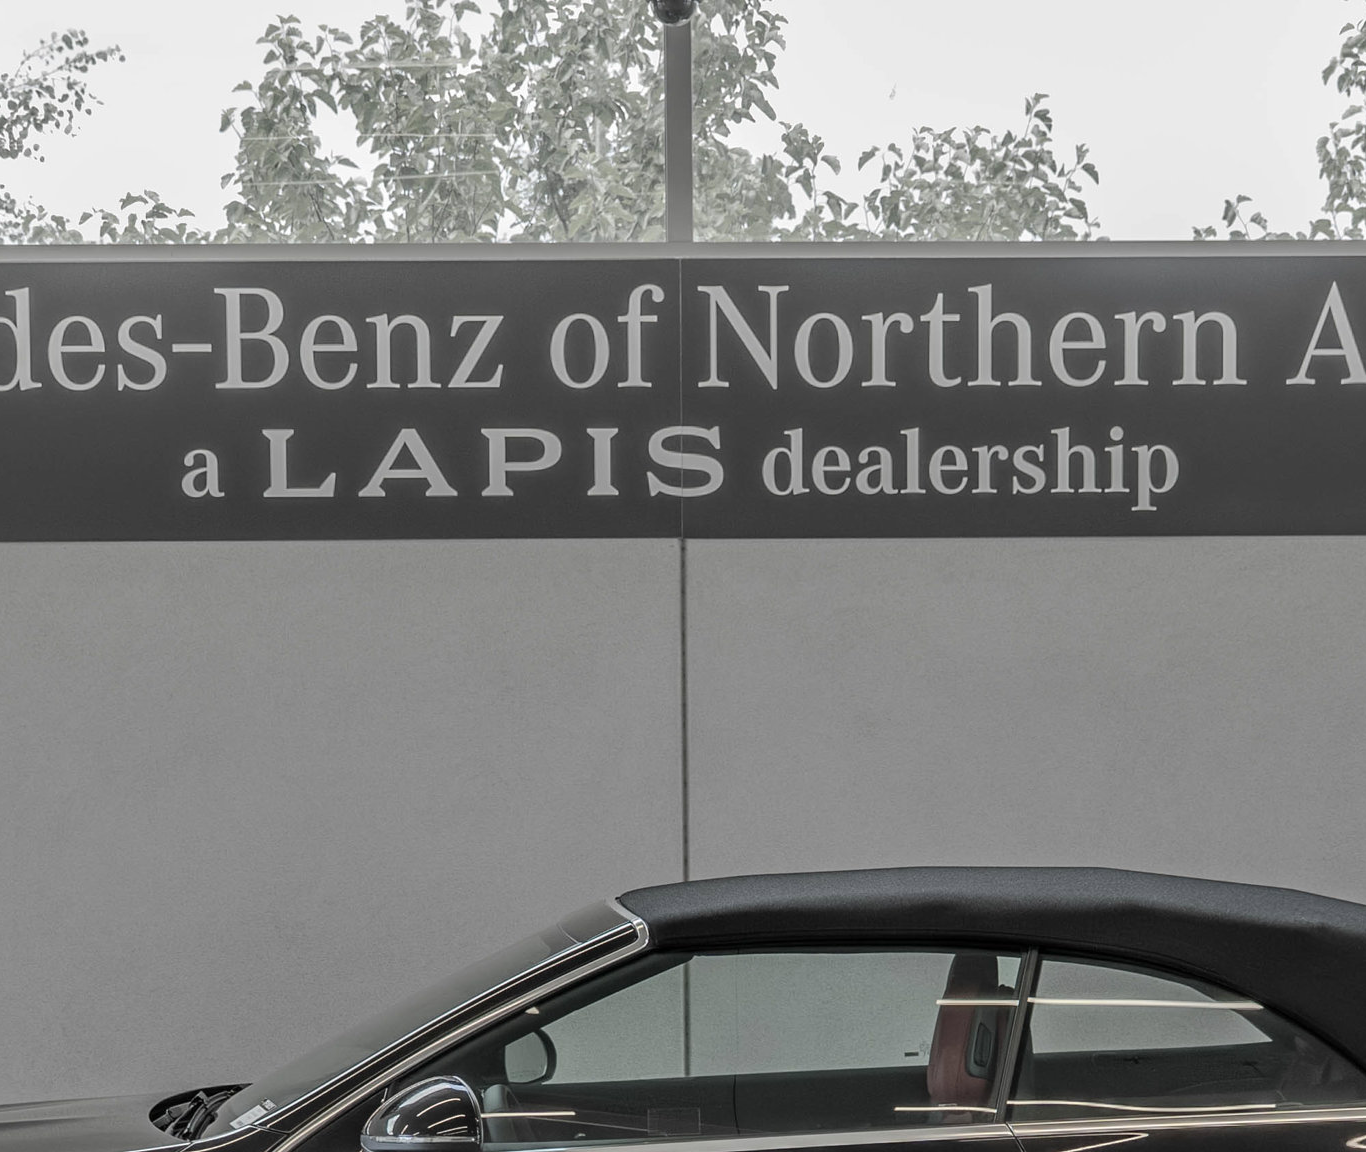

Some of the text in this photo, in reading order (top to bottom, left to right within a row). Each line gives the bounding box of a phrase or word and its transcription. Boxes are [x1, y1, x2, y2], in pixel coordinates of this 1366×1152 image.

[549, 283, 665, 389] of
[696, 283, 1248, 390] Northern
[181, 425, 1179, 512] a LAPIS dealership
